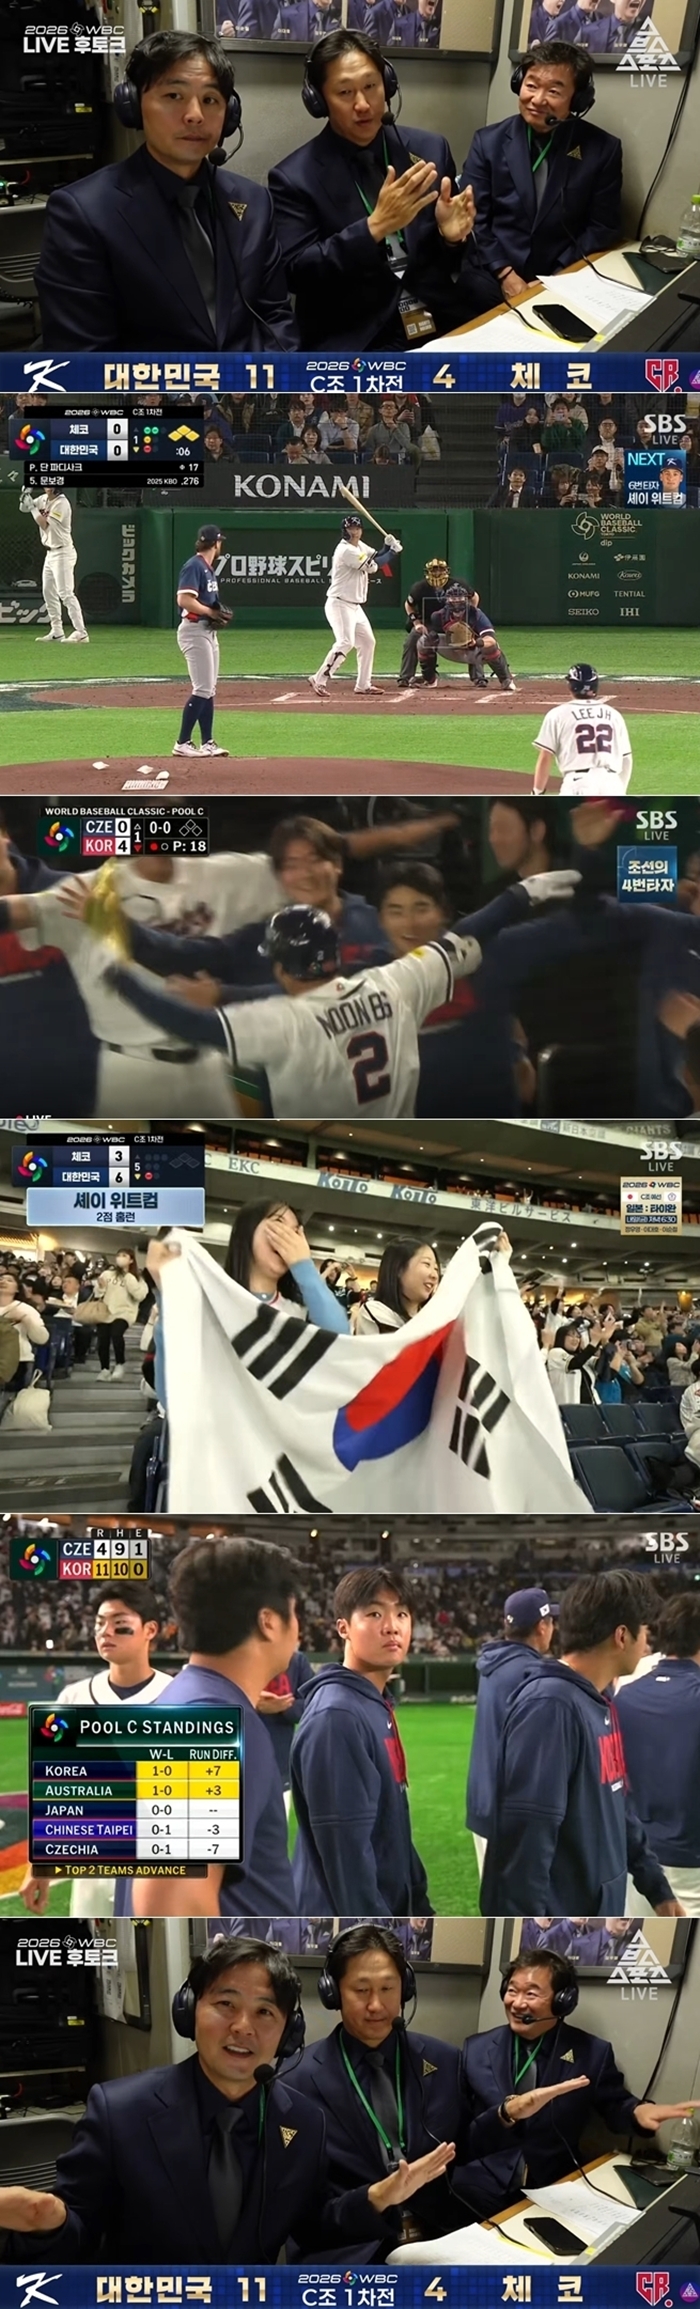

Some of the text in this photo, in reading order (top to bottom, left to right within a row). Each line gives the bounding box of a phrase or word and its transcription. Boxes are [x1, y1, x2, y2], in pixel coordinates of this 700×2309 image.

[234, 474, 370, 498] KONAMI
[568, 608, 599, 616] SEIKO
[620, 608, 640, 616] IHI
[571, 708, 595, 720] LEE
[575, 723, 613, 754] 22
[346, 1031, 391, 1105] 2
[229, 1157, 260, 1174] EKC
